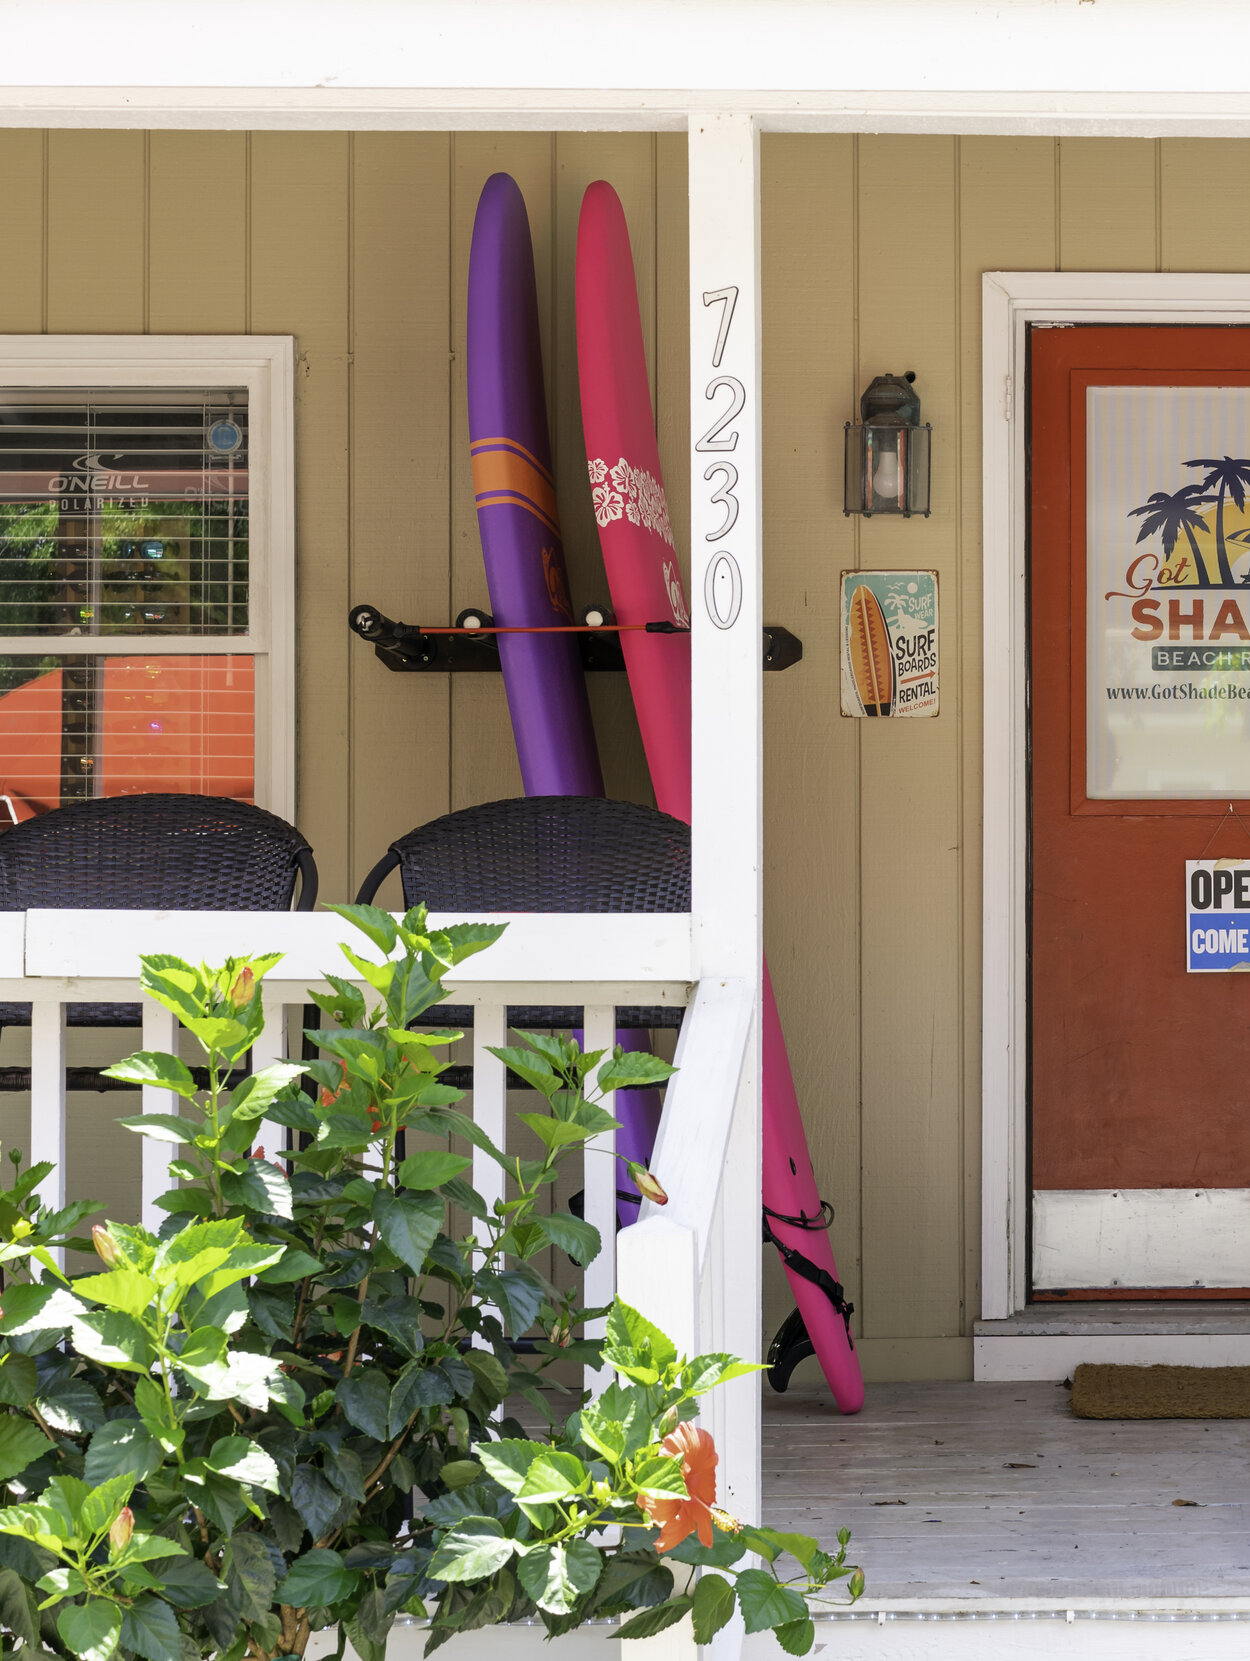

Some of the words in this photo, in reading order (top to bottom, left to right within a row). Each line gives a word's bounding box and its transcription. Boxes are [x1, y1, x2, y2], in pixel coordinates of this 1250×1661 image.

[695, 286, 746, 630] 7230
[48, 474, 149, 492] O'NEILL
[50, 497, 149, 511] POLARIZED
[1105, 553, 1191, 601] Got
[908, 593, 933, 613] SURF
[914, 608, 934, 620] WEAR
[896, 629, 936, 661] SURF
[898, 653, 937, 677] BOARDS
[1157, 651, 1233, 665] BEACH
[899, 681, 936, 704] RENTAL
[898, 698, 936, 714] WELCOME!
[1192, 928, 1249, 954] COME
